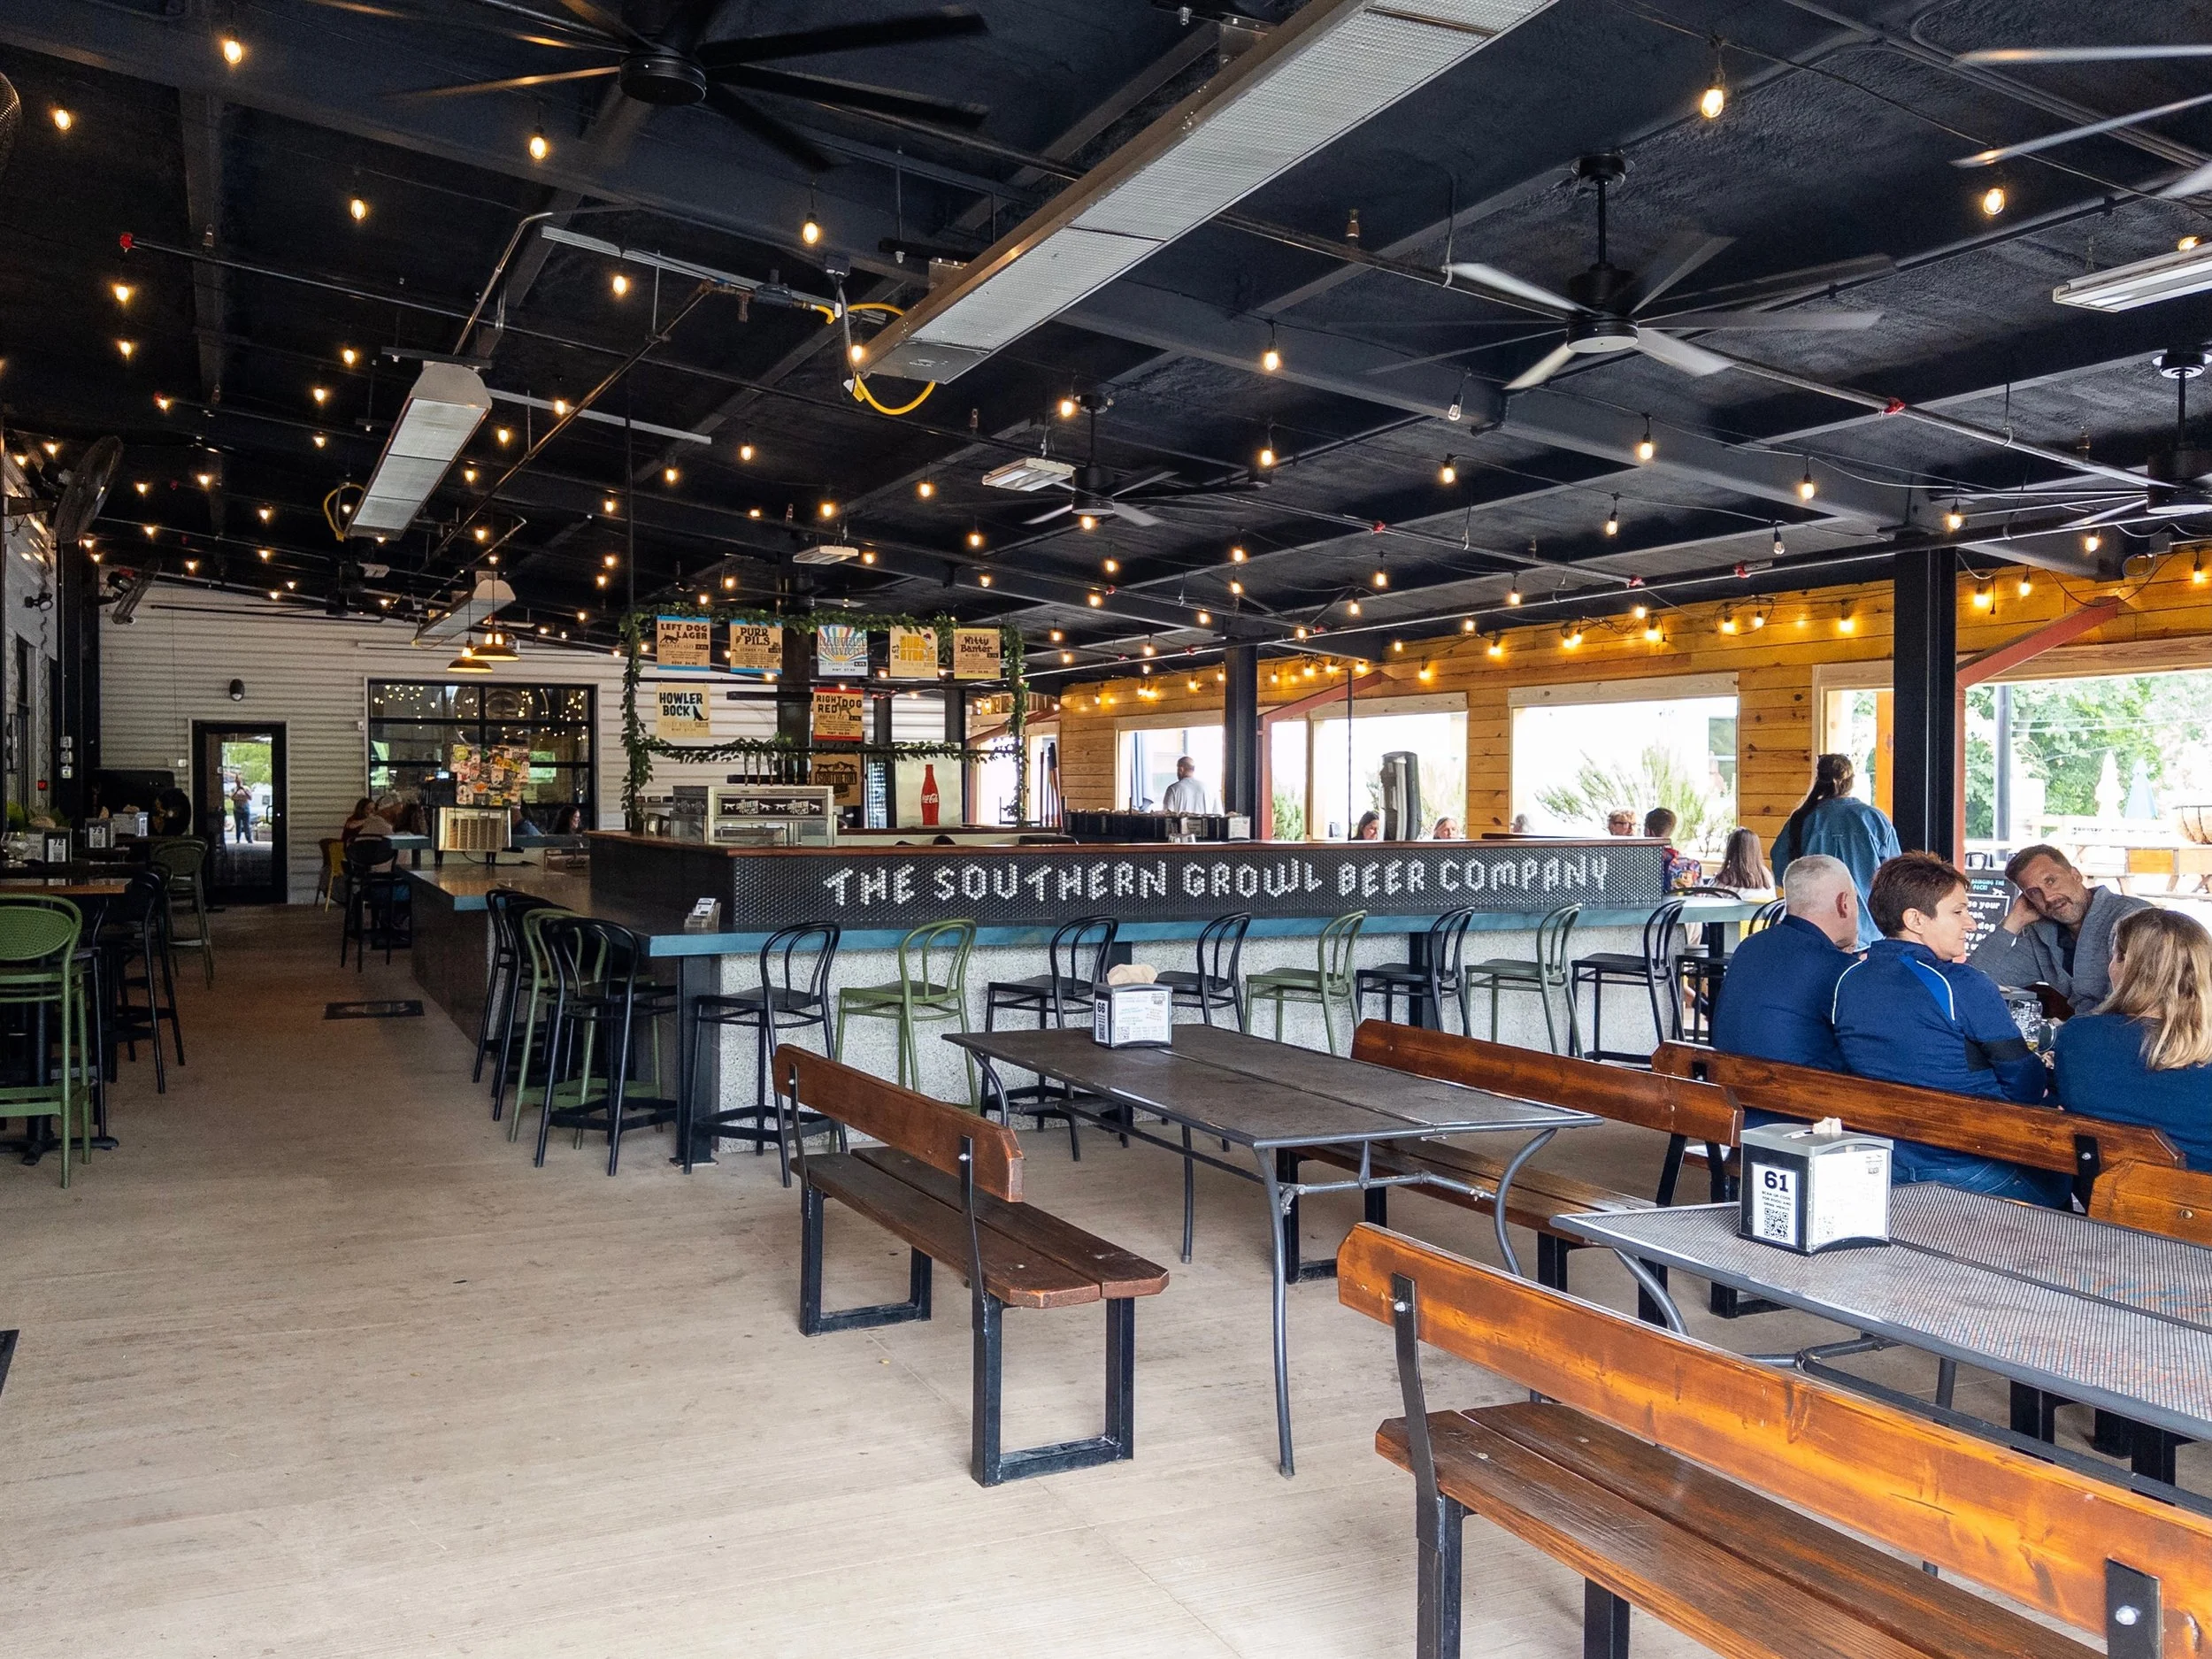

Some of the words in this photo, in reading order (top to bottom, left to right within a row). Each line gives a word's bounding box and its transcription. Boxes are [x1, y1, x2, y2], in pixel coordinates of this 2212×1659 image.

[676, 631, 708, 640] LAGER
[740, 627, 769, 637] PURR
[744, 636, 771, 645] PILS
[964, 636, 989, 645] Witty
[960, 644, 993, 653] Banter
[659, 692, 703, 704] HOWLER
[816, 695, 842, 703] RIGHT
[841, 699, 862, 708] DOG
[663, 704, 690, 716] BOCK
[818, 703, 838, 713] RED
[823, 863, 915, 905] THE
[933, 860, 1166, 901] SOUTHERN
[1182, 857, 1323, 898] GROWL
[1337, 858, 1425, 898] BEER
[1438, 854, 1608, 893] COMPANY
[1978, 901, 2001, 910] your
[1977, 921, 1996, 933] dog
[1097, 1002, 1106, 1013] 66
[1764, 1171, 1788, 1192] 61
